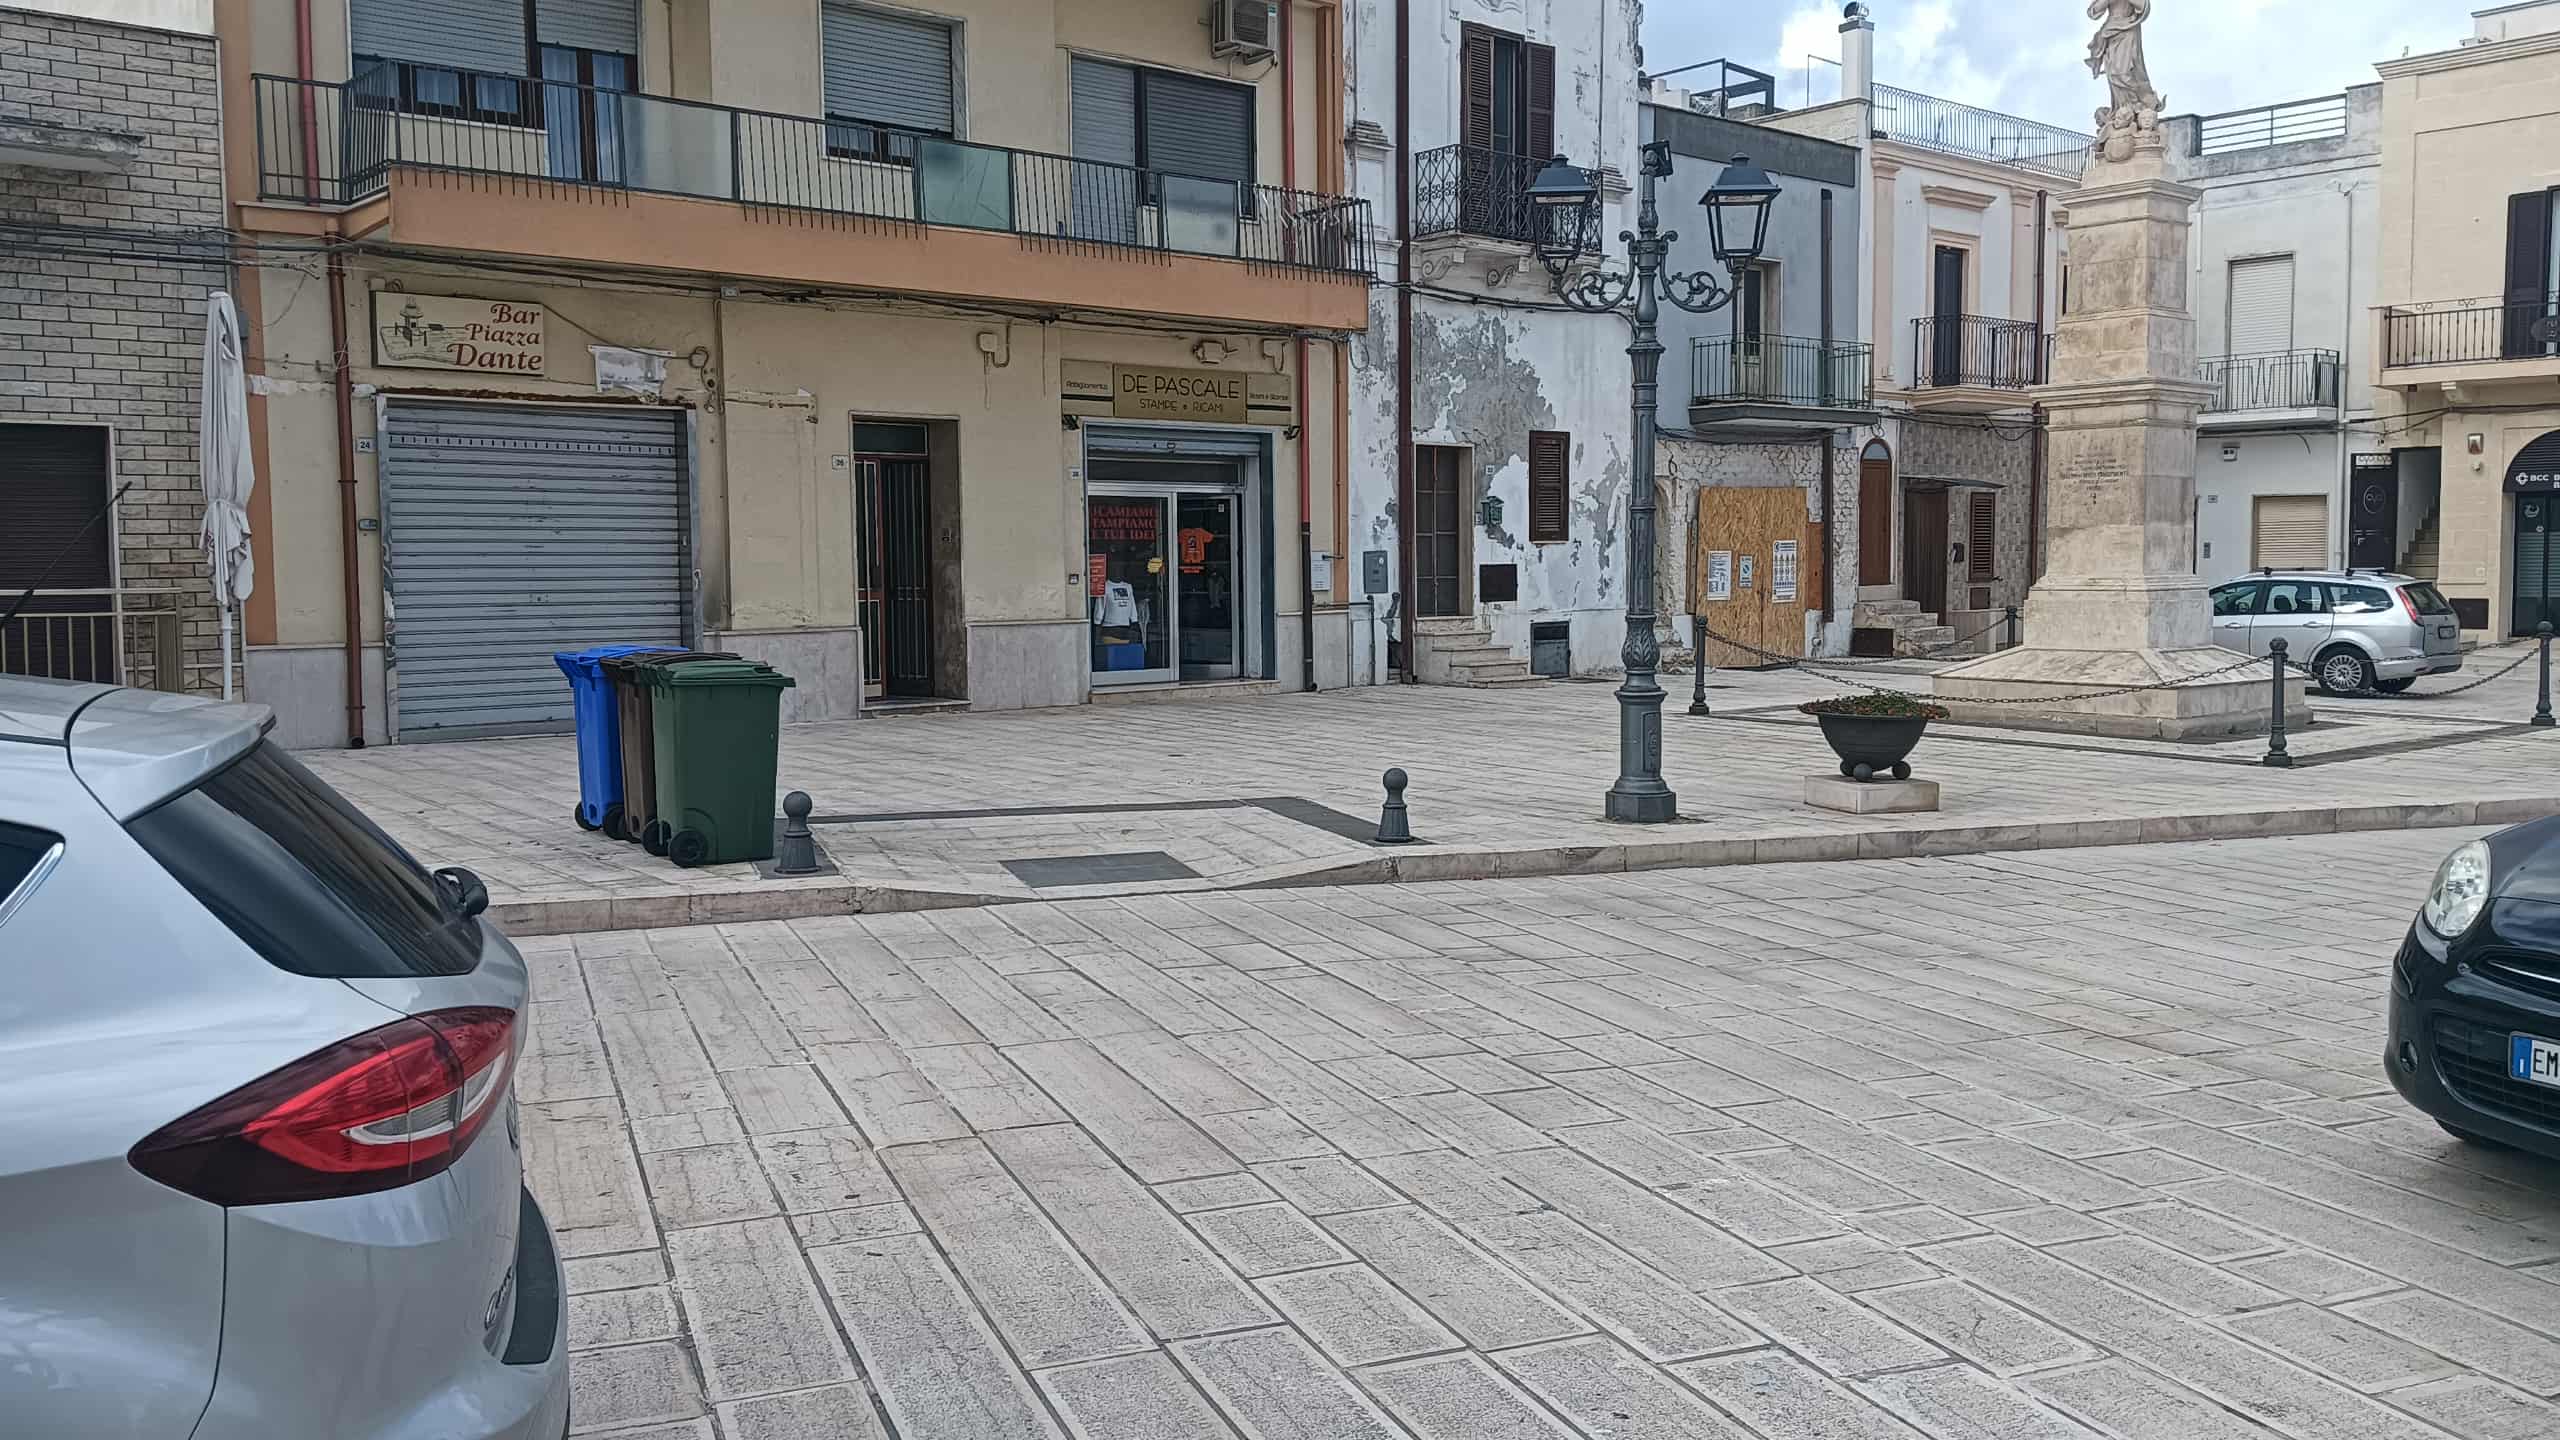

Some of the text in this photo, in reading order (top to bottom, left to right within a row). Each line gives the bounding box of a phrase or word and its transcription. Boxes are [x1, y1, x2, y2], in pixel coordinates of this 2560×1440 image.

[490, 303, 540, 324] Bar
[464, 323, 540, 346] Piazza
[446, 343, 542, 370] Dante
[1122, 374, 1241, 399] DE PASCALE
[1139, 399, 1224, 413] STAMPE RICAMI
[360, 441, 370, 449] 24
[1090, 517, 1156, 529] TAMPIAMO
